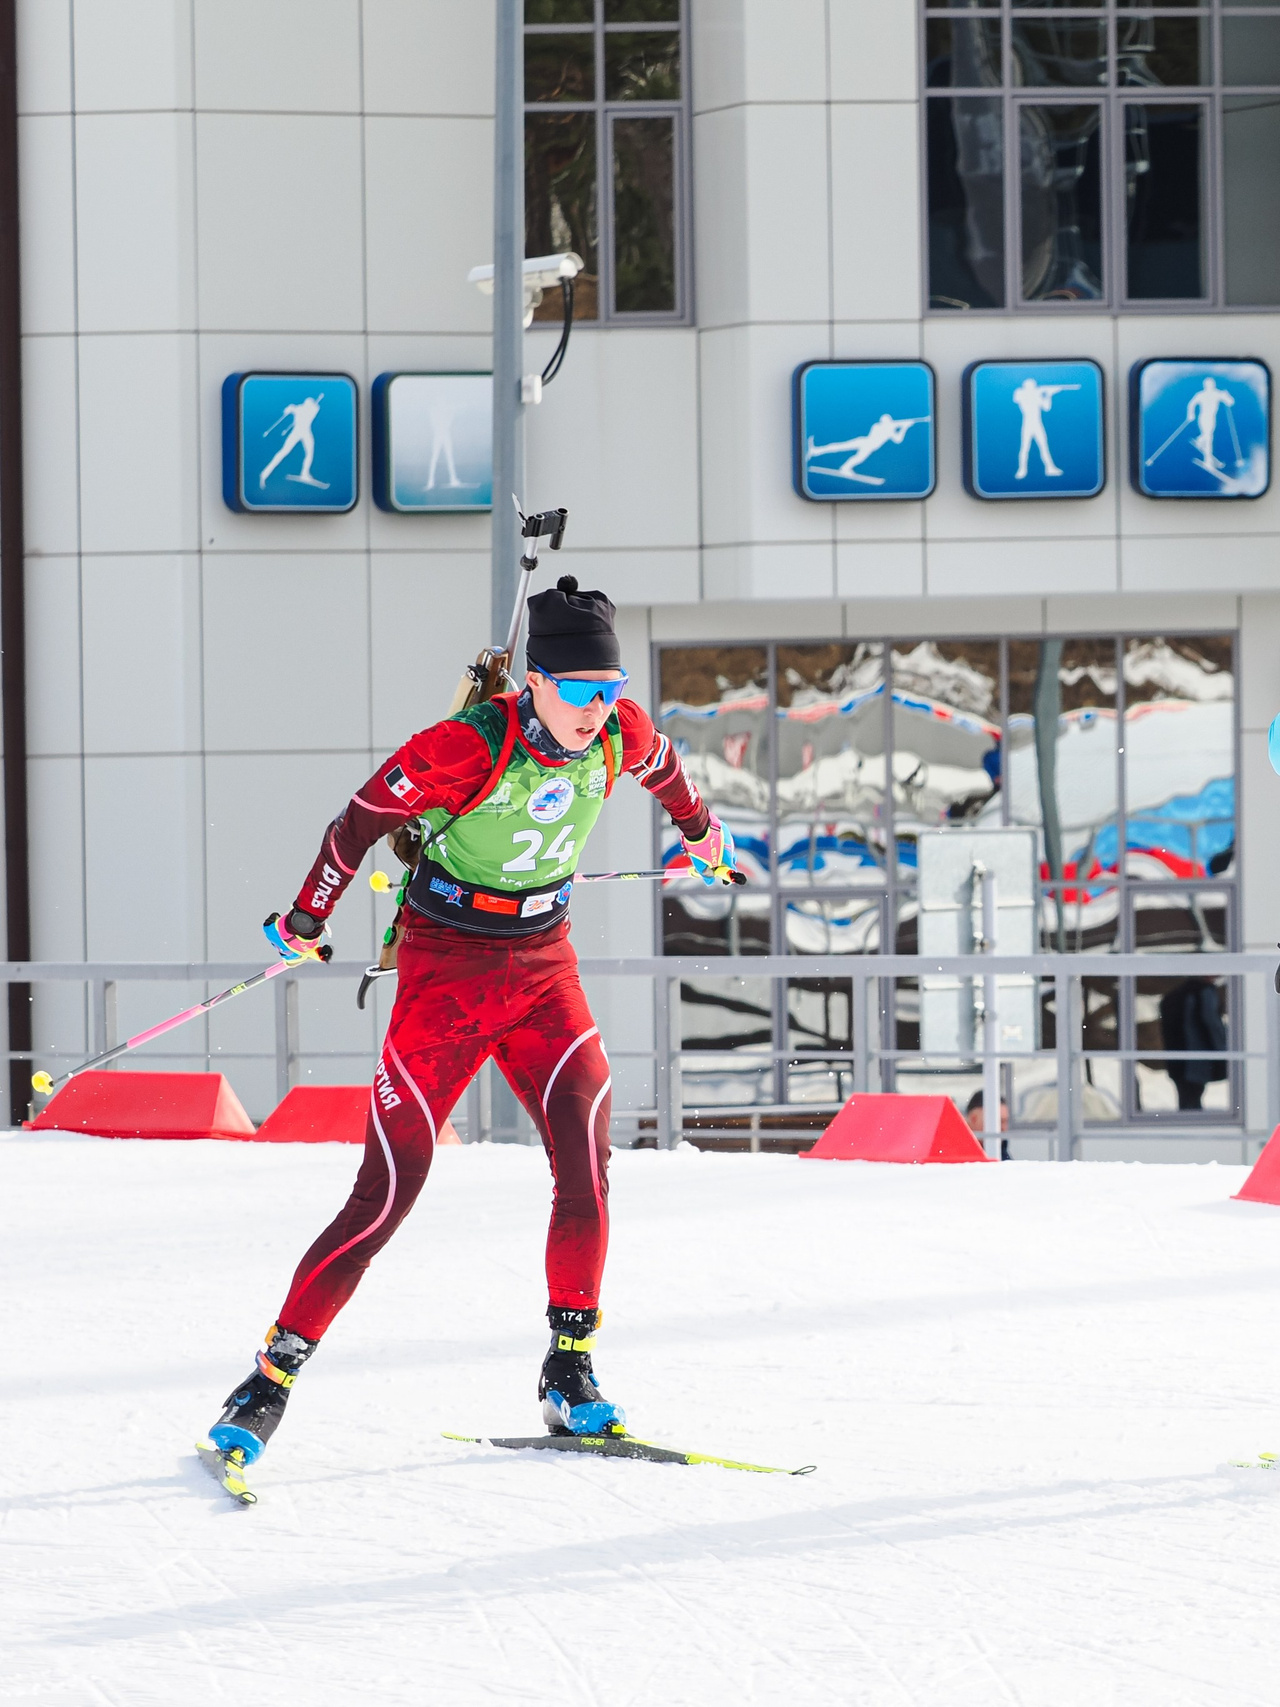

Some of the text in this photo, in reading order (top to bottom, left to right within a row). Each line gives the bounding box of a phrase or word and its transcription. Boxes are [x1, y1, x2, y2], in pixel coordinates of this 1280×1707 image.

[502, 824, 576, 872] 24
[561, 1312, 583, 1323] 174
[581, 1437, 605, 1446] FISCHER
